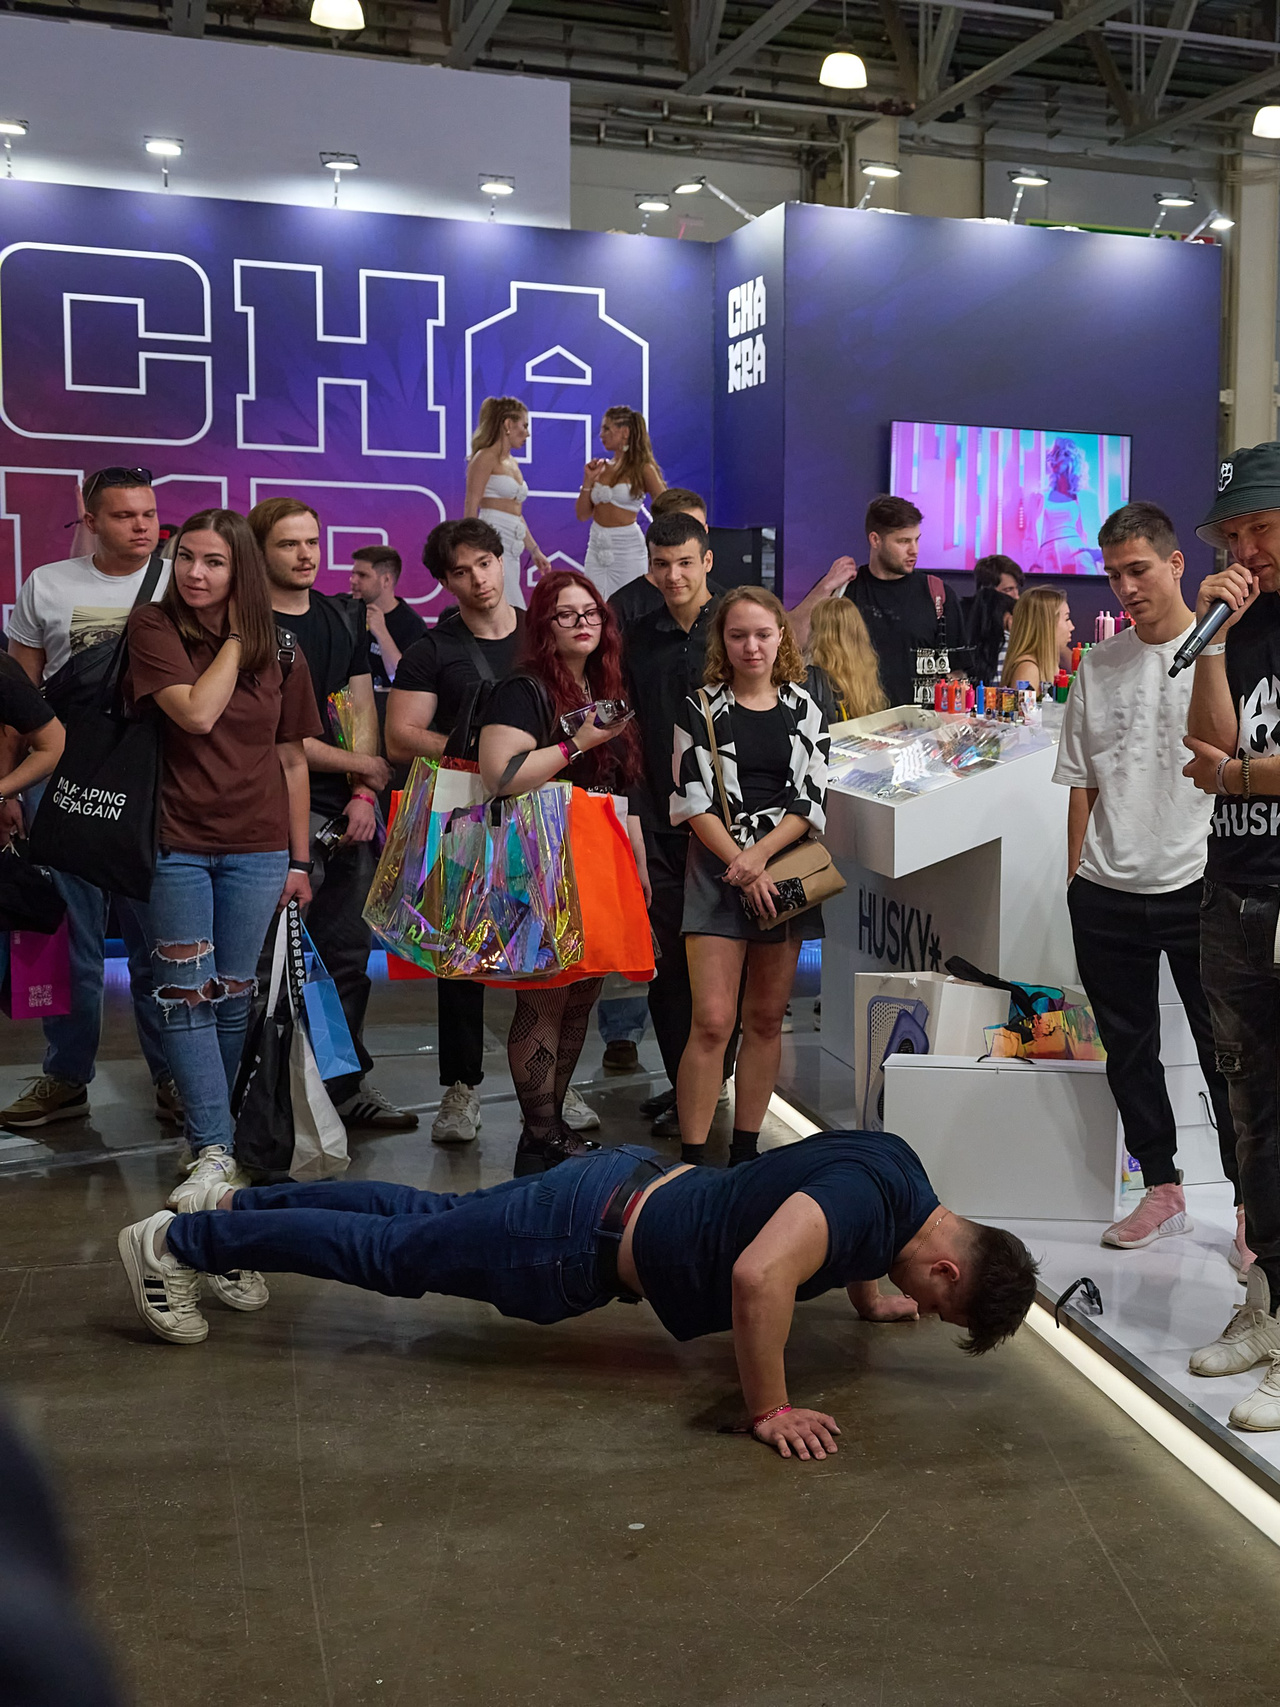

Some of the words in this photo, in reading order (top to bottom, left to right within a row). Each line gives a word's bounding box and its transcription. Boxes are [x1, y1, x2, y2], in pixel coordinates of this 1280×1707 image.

[728, 275, 766, 338] CHA
[0, 241, 650, 463] CHA
[72, 801, 122, 821] AGAIN
[80, 787, 127, 807] APING
